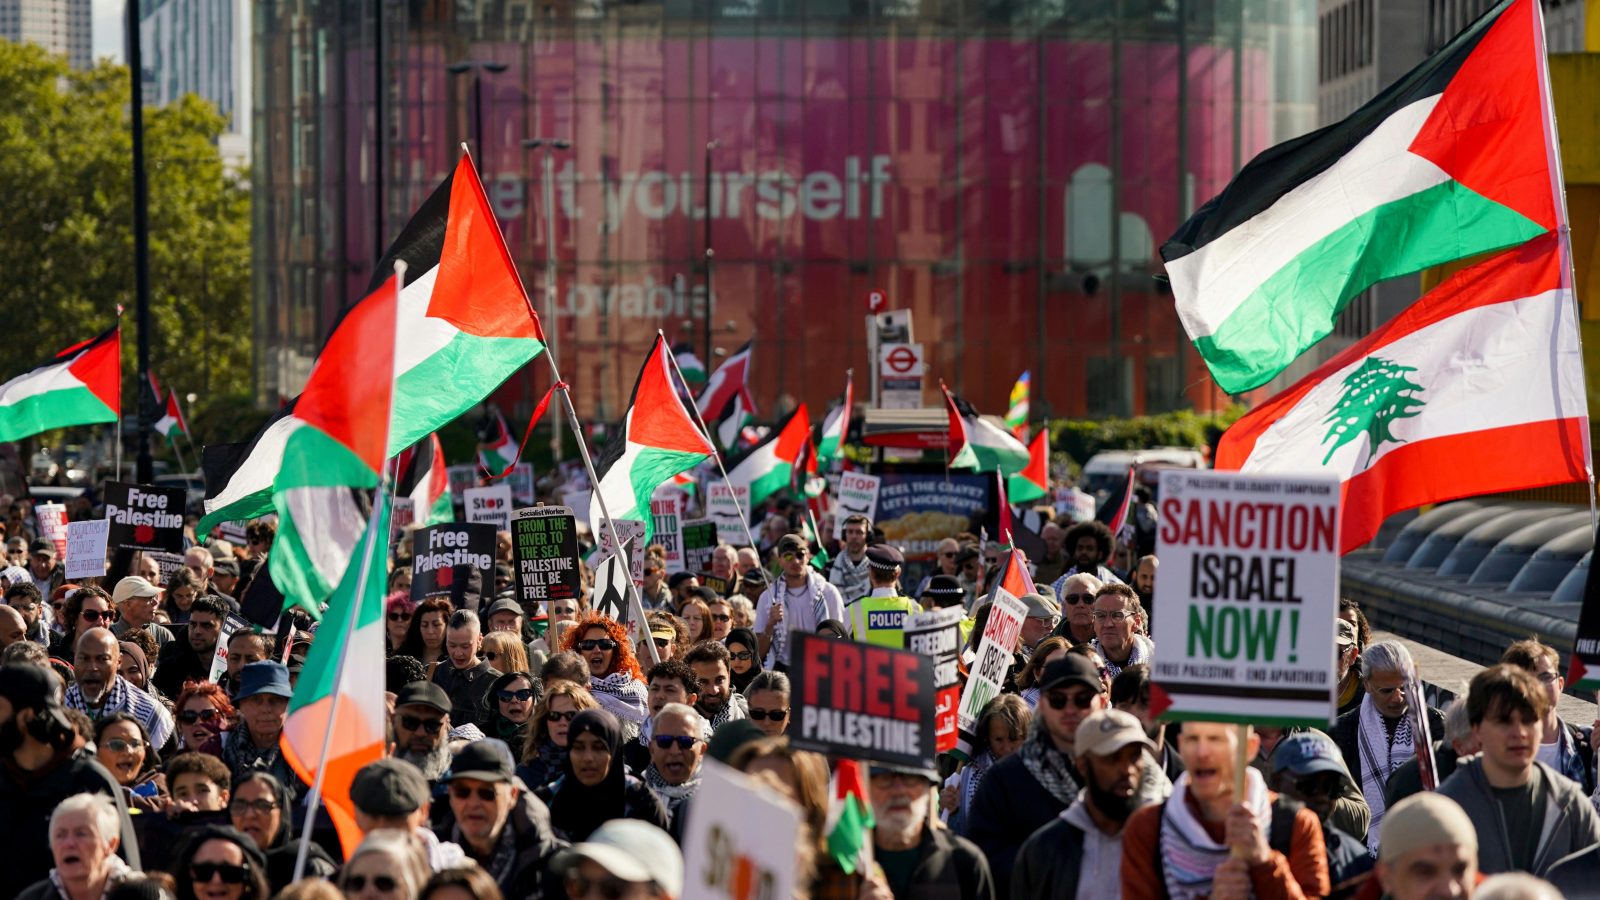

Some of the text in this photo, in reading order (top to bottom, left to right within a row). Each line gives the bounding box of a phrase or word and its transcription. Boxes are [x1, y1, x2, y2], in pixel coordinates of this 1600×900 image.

[597, 155, 892, 234] yourself
[870, 292, 882, 310] P
[711, 485, 746, 496] STOP
[843, 476, 876, 490] STOP
[881, 485, 909, 497] FEEL
[911, 481, 936, 493] THE
[1187, 479, 1331, 495] PALESTINE SOLIDARITY CAMPAIGN
[127, 487, 168, 509] Free
[472, 497, 504, 510] Stop
[661, 500, 675, 514] THE
[105, 503, 183, 529] Palestine
[472, 511, 507, 521] Arming
[518, 519, 546, 533] FROM
[548, 517, 567, 531] THE
[1161, 497, 1335, 552] SANCTION
[429, 529, 469, 550] Free
[518, 531, 563, 546] RIVER TO
[520, 544, 560, 559] THE SEA
[415, 548, 492, 574] Palestine
[521, 557, 573, 573] PALESTINE
[522, 571, 562, 586] WILL BE
[1190, 553, 1303, 604] ISRAEL
[523, 586, 548, 599] FREE
[804, 635, 921, 722] FREE
[1155, 663, 1180, 677] FREE
[1182, 664, 1236, 680] PALESTINE
[1246, 668, 1267, 681] END
[1270, 669, 1327, 684] APARTHEID
[801, 704, 922, 756] PALESTINE
